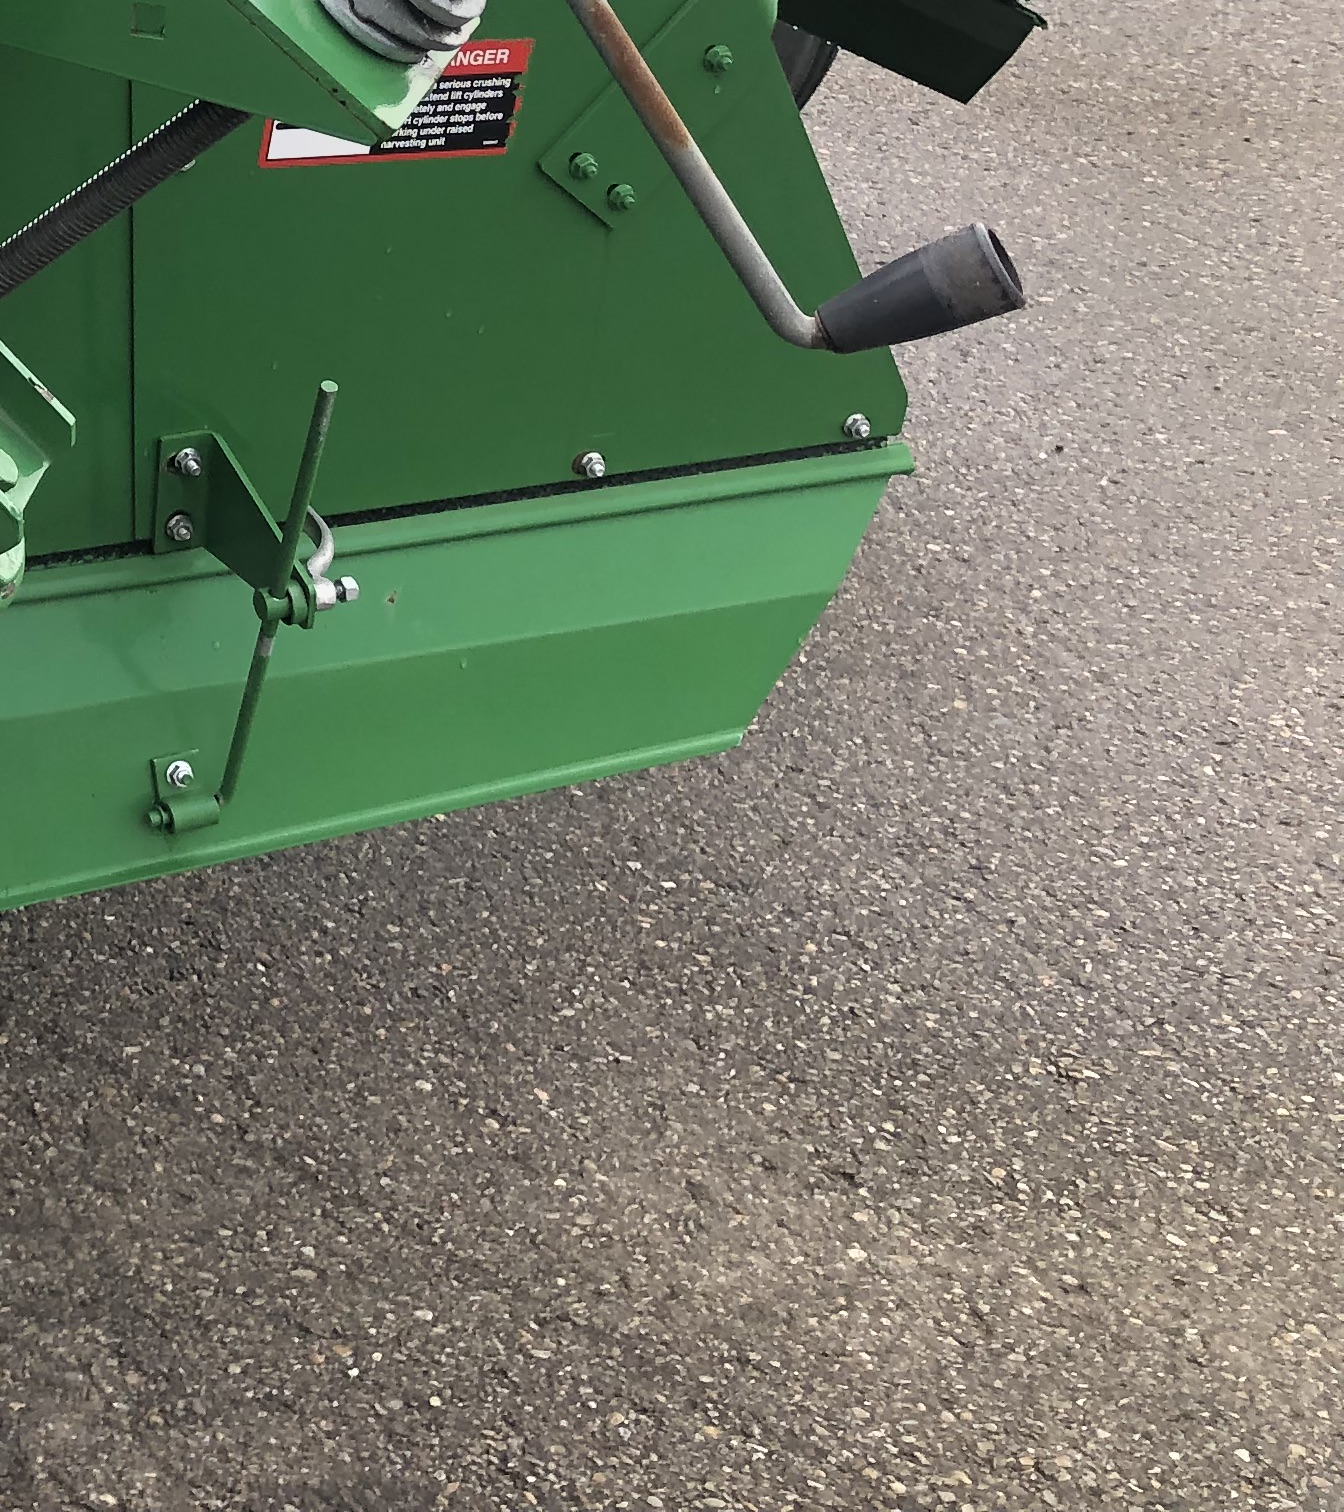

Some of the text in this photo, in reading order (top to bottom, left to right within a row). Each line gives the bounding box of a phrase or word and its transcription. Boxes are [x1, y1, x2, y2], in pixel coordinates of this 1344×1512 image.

[451, 48, 510, 67] NGER
[439, 79, 472, 90] serious
[473, 77, 512, 89] crushing
[451, 90, 463, 100] lift
[463, 89, 503, 101] cylinders
[437, 103, 454, 113] and
[455, 101, 487, 113] engage
[412, 114, 448, 126] cylinder
[449, 113, 474, 124] stops
[475, 111, 504, 122] before
[419, 125, 446, 135] under
[446, 124, 474, 134] raised
[428, 136, 446, 146] unit
